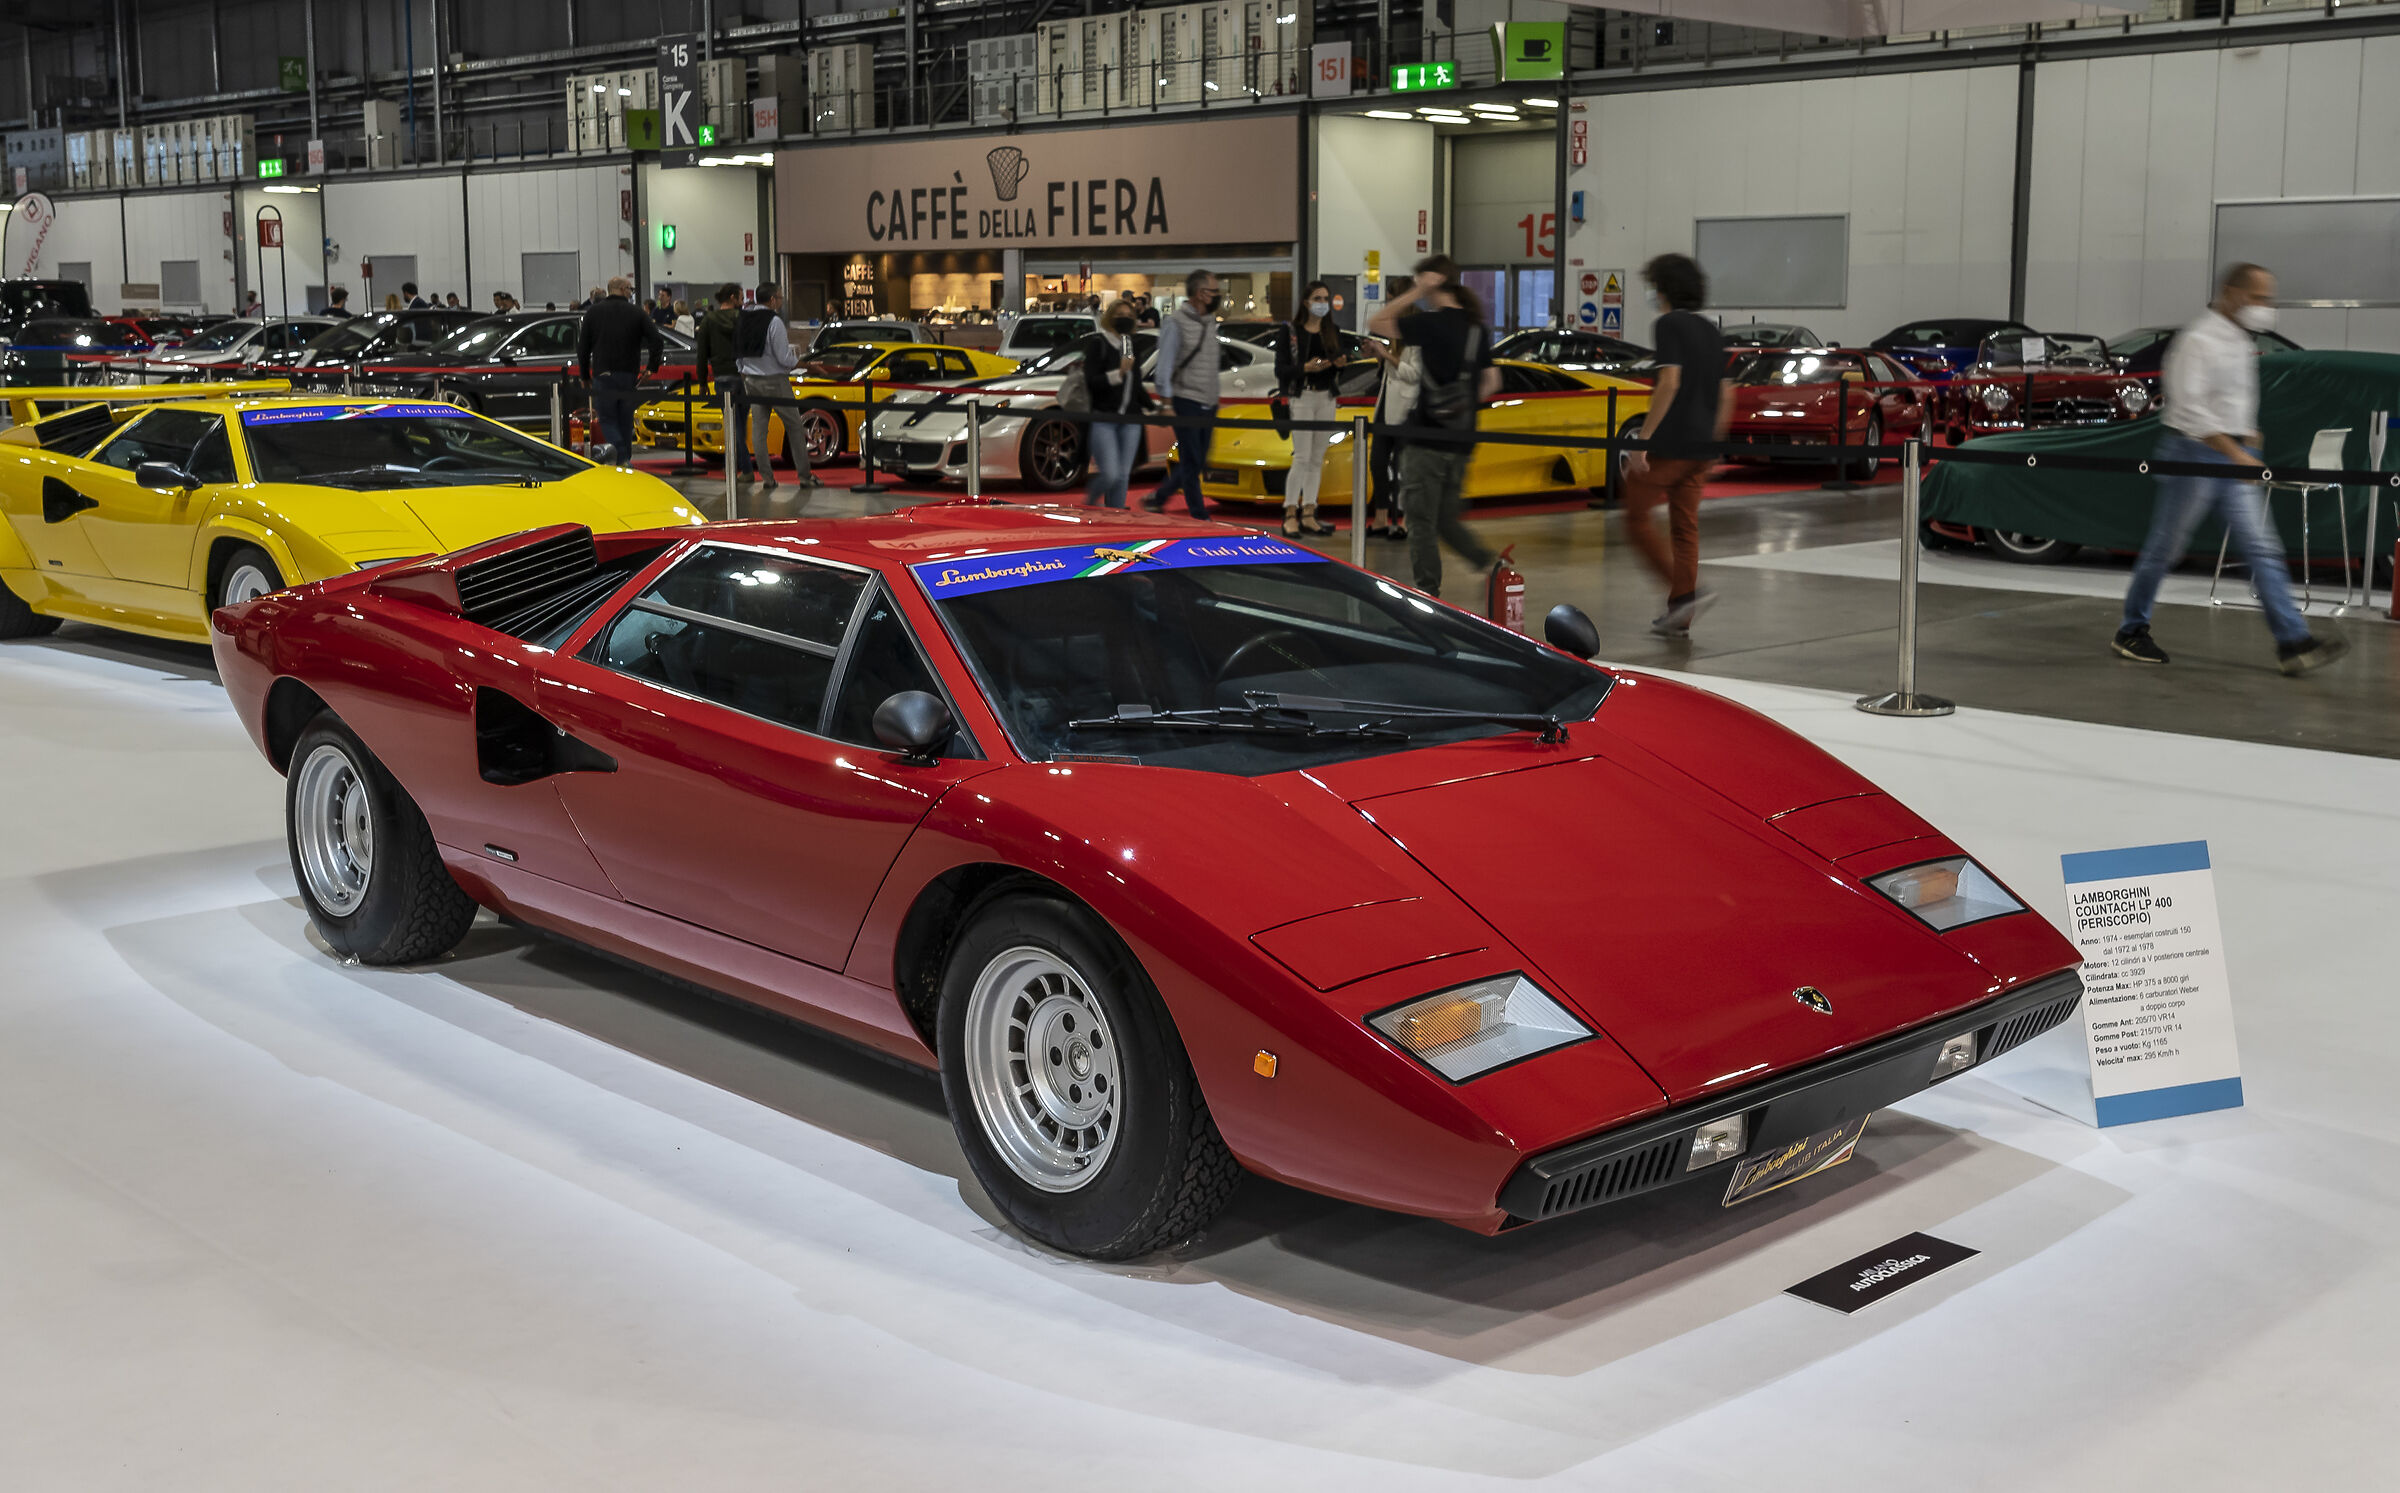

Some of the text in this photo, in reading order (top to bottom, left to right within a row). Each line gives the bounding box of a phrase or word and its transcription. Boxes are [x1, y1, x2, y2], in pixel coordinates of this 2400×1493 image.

[671, 44, 688, 67] 15
[664, 90, 695, 146] K
[754, 108, 777, 128] 15H
[866, 169, 1169, 241] CAFFÈ DELLA FIERA
[24, 215, 53, 273] VIGANO
[1517, 213, 1556, 258] 15
[843, 260, 874, 280] CAFFÈ
[844, 299, 875, 316] FIERA
[251, 411, 323, 422] Lamborghini
[935, 545, 1296, 587] Lamborghini Club Italia
[2073, 886, 2150, 905] LAMBORGHINI
[2075, 896, 2172, 917] COUNTACH LP 400
[2077, 911, 2151, 932] (PERISCOPIO)
[2080, 937, 2101, 946] Anno:
[2103, 935, 2118, 943] 1974
[2123, 931, 2154, 940] esemplari
[2155, 928, 2179, 937] costruiti
[2180, 926, 2191, 934] 150
[2084, 960, 2110, 970] Motore:
[2112, 959, 2119, 967] 12
[2120, 956, 2141, 965] cilindri
[2147, 954, 2153, 962] V
[2154, 951, 2184, 962] posteriore
[2185, 948, 2209, 957] centrale
[2103, 948, 2113, 956] dal
[2115, 945, 2130, 954] 1972
[2139, 942, 2154, 951] 1978
[2085, 971, 2119, 982] Cilindrata:
[2130, 968, 2145, 976] 3929
[2087, 985, 2114, 994] Potenza
[2115, 982, 2131, 990] Max:
[2133, 980, 2143, 988] HP
[2145, 979, 2156, 987] 375
[2163, 975, 2179, 984] 8000
[2179, 974, 2190, 983] giri
[2089, 985, 2199, 1006] Alimentazione: 6 carburatori Weber
[2145, 1001, 2167, 1011] doppio
[2168, 1000, 2185, 1009] corpo
[2092, 1012, 2175, 1030] Gomme Ant: 205/70 VR14
[2093, 1023, 2182, 1042] Gomme Post: 215/70 VR 14
[2095, 1046, 2113, 1054] Peso
[2119, 1042, 2141, 1051] vuoto:
[2142, 1040, 2152, 1049] Kg
[2153, 1037, 2168, 1046] 1165
[2097, 1055, 2125, 1066] Velocita'
[2126, 1054, 2143, 1062] max:
[2144, 1051, 2157, 1060] 295
[2157, 1049, 2174, 1058] Km/h
[1784, 1129, 1842, 1175] CLUB ITALIA
[1734, 1136, 1809, 1195] Lamborghini
[1850, 1254, 1931, 1292] AUTOCLASSICA
